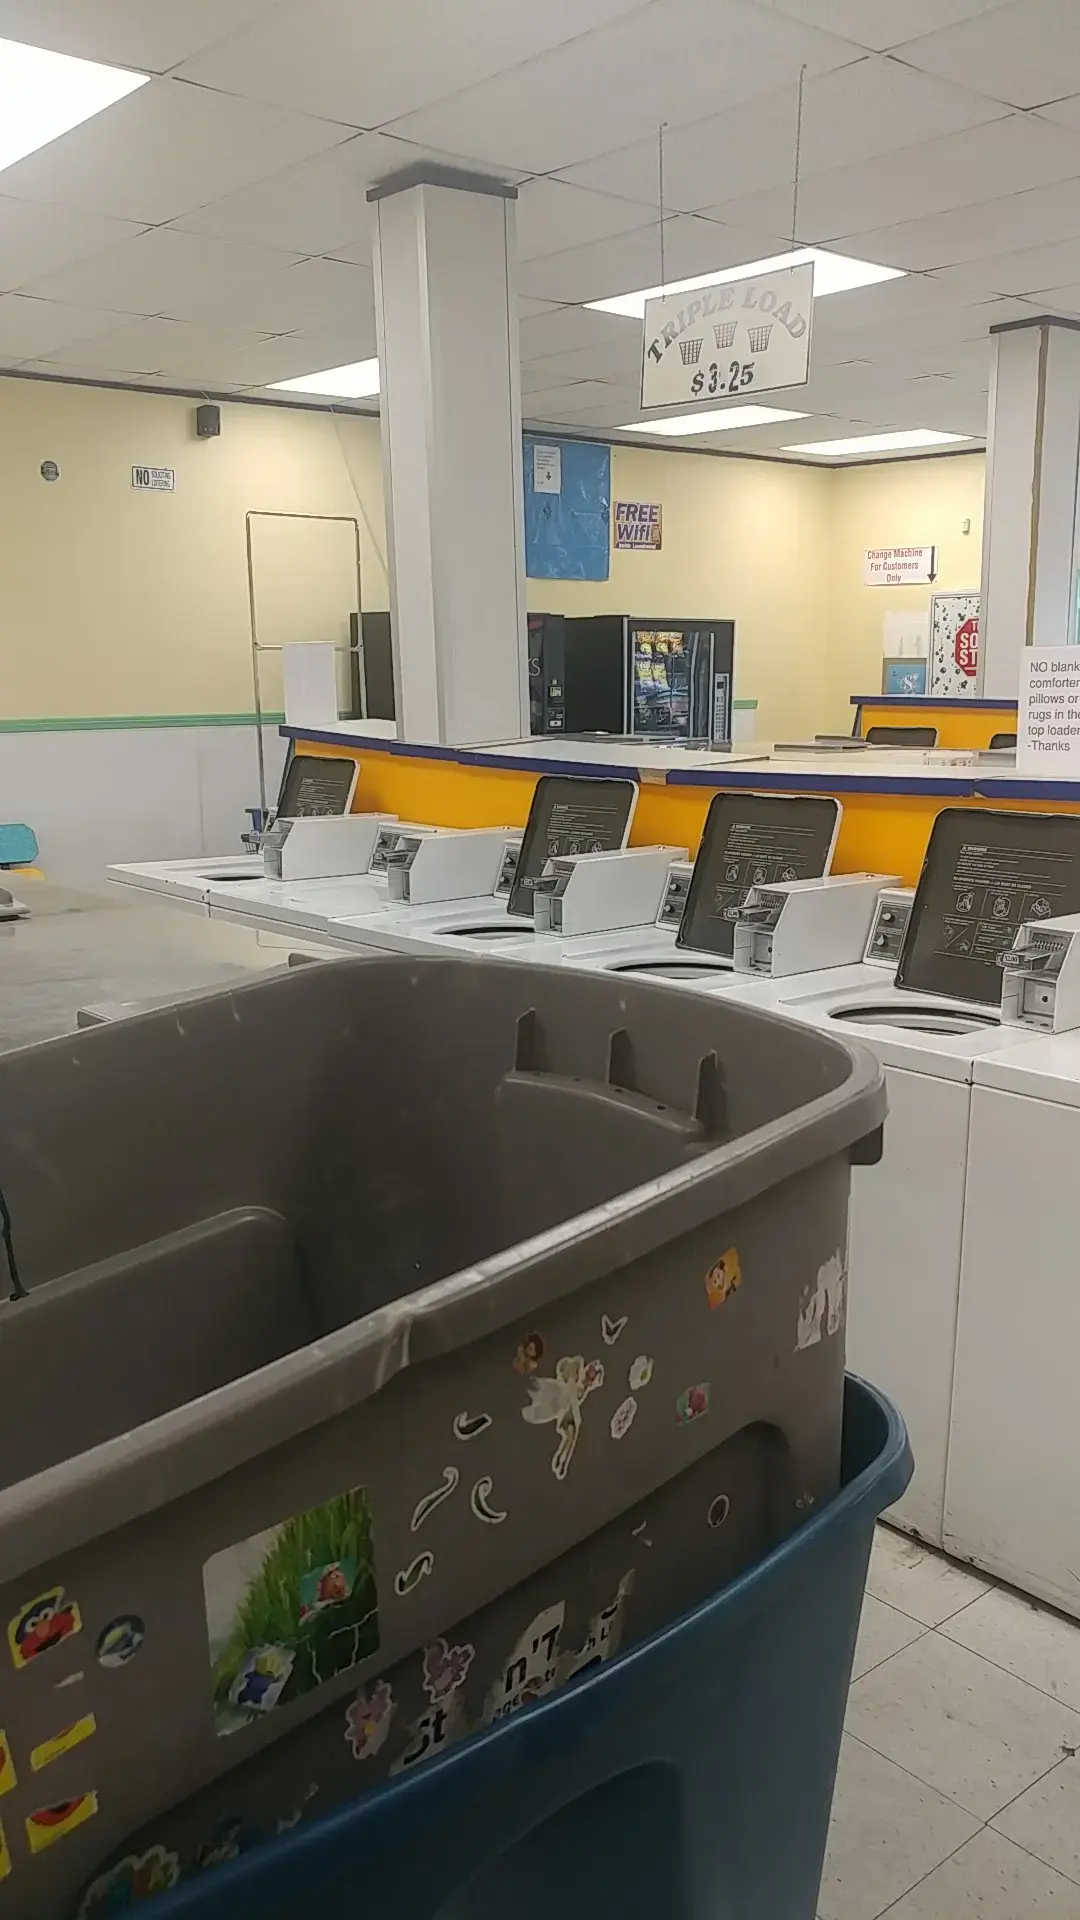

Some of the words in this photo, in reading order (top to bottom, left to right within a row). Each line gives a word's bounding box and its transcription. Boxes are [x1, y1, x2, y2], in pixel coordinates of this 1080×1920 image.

[647, 286, 735, 364] TRIPLE
[741, 286, 807, 339] LOAD
[690, 361, 755, 396] $3.25
[135, 469, 150, 486] NO
[615, 502, 660, 523] FREE
[867, 550, 892, 560] Change
[893, 548, 923, 558] Machine
[870, 562, 881, 571] For
[882, 561, 919, 571] Customers
[886, 573, 902, 583] Only
[1030, 661, 1048, 672] NO
[1028, 693, 1065, 706] pillows
[1067, 695, 1079, 703] or
[1028, 711, 1052, 722] rugs
[1054, 709, 1064, 719] in
[1028, 725, 1045, 737] top
[1027, 740, 1071, 751] -Thanks
